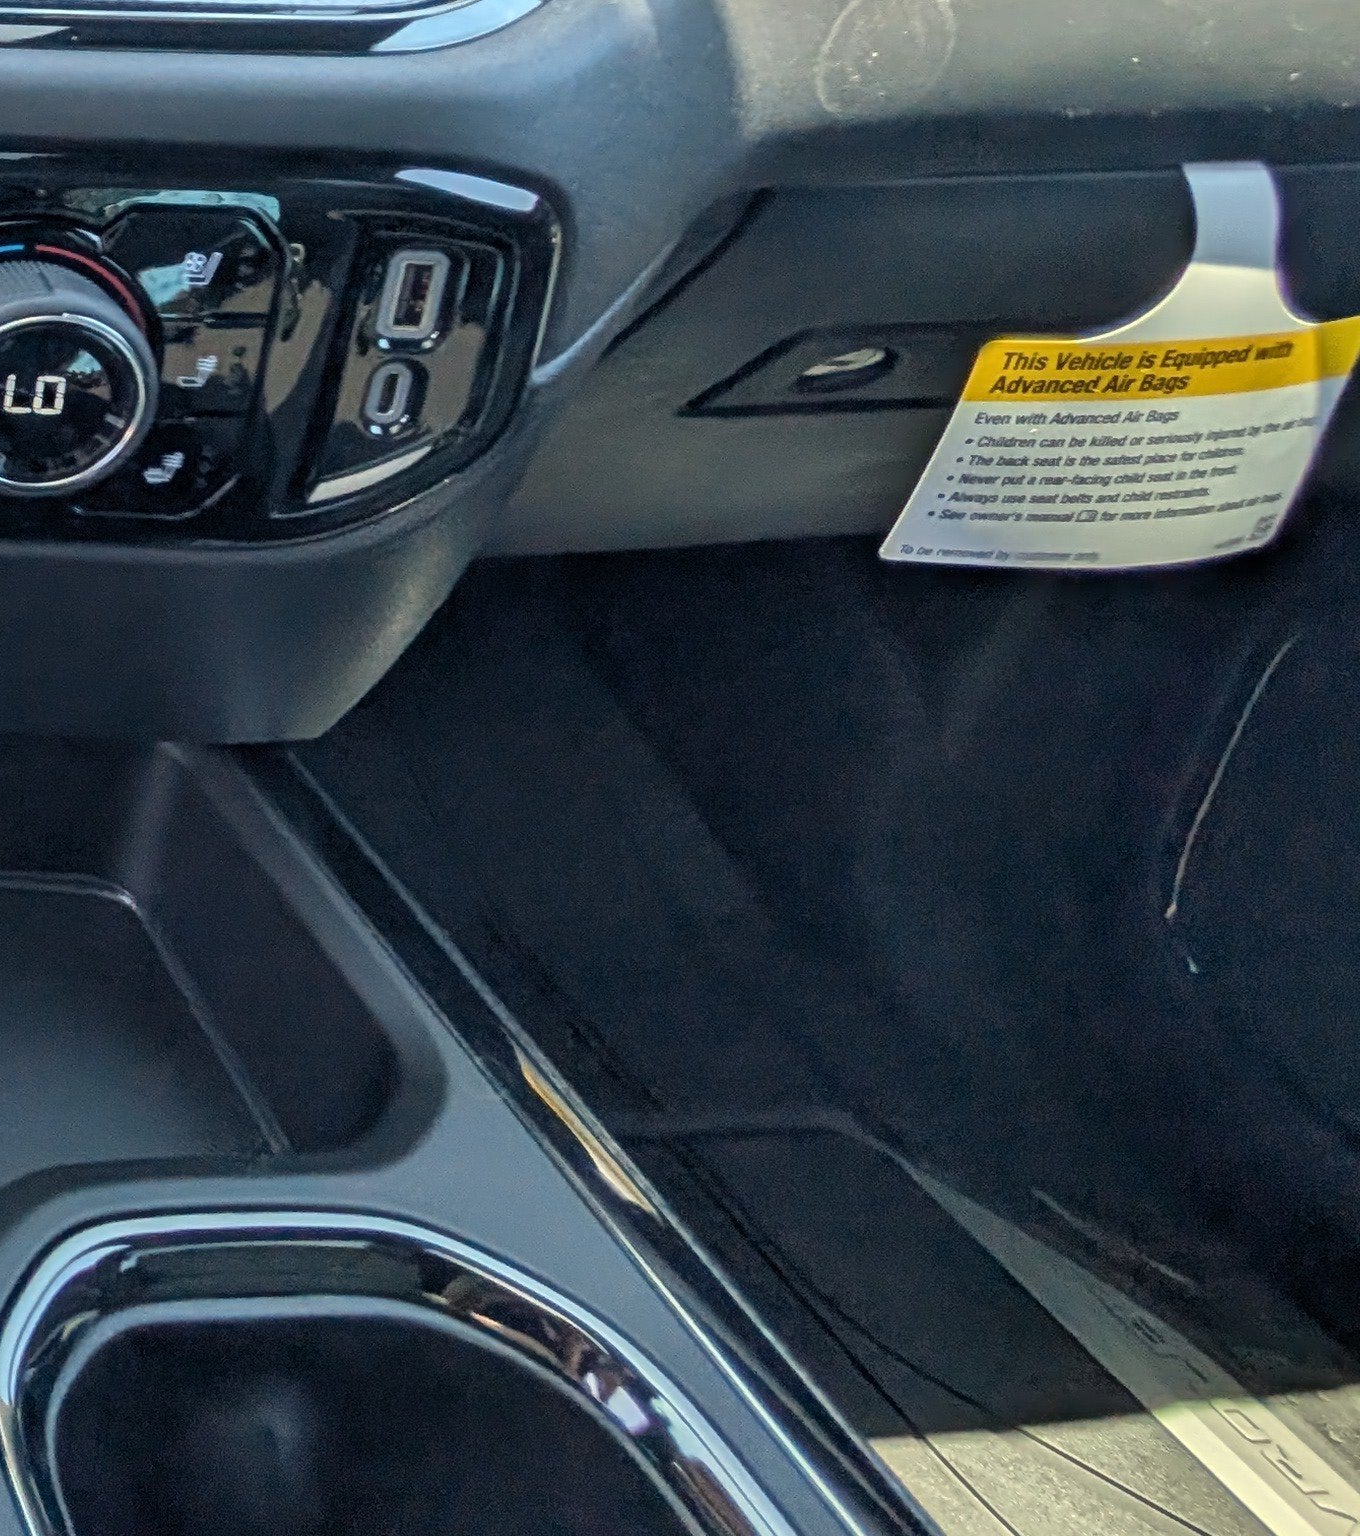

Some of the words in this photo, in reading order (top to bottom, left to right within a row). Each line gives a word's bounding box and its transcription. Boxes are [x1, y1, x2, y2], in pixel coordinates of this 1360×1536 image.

[1002, 351, 1049, 372] This
[1056, 351, 1133, 371] Vehicle
[1136, 350, 1158, 369] is
[1160, 344, 1254, 370] Equipped
[2, 373, 67, 415] LO
[989, 375, 1102, 394] Advanced
[1102, 375, 1137, 393] Air
[1137, 374, 1191, 395] Bags
[974, 412, 1011, 425] Even
[1015, 412, 1047, 425] with
[1049, 411, 1122, 425] Advanced
[1122, 410, 1143, 423] Air
[1145, 409, 1180, 424] Bags
[977, 435, 1037, 448] Children
[1038, 438, 1067, 448] can
[1068, 436, 1088, 448] be
[1088, 435, 1128, 448] killed
